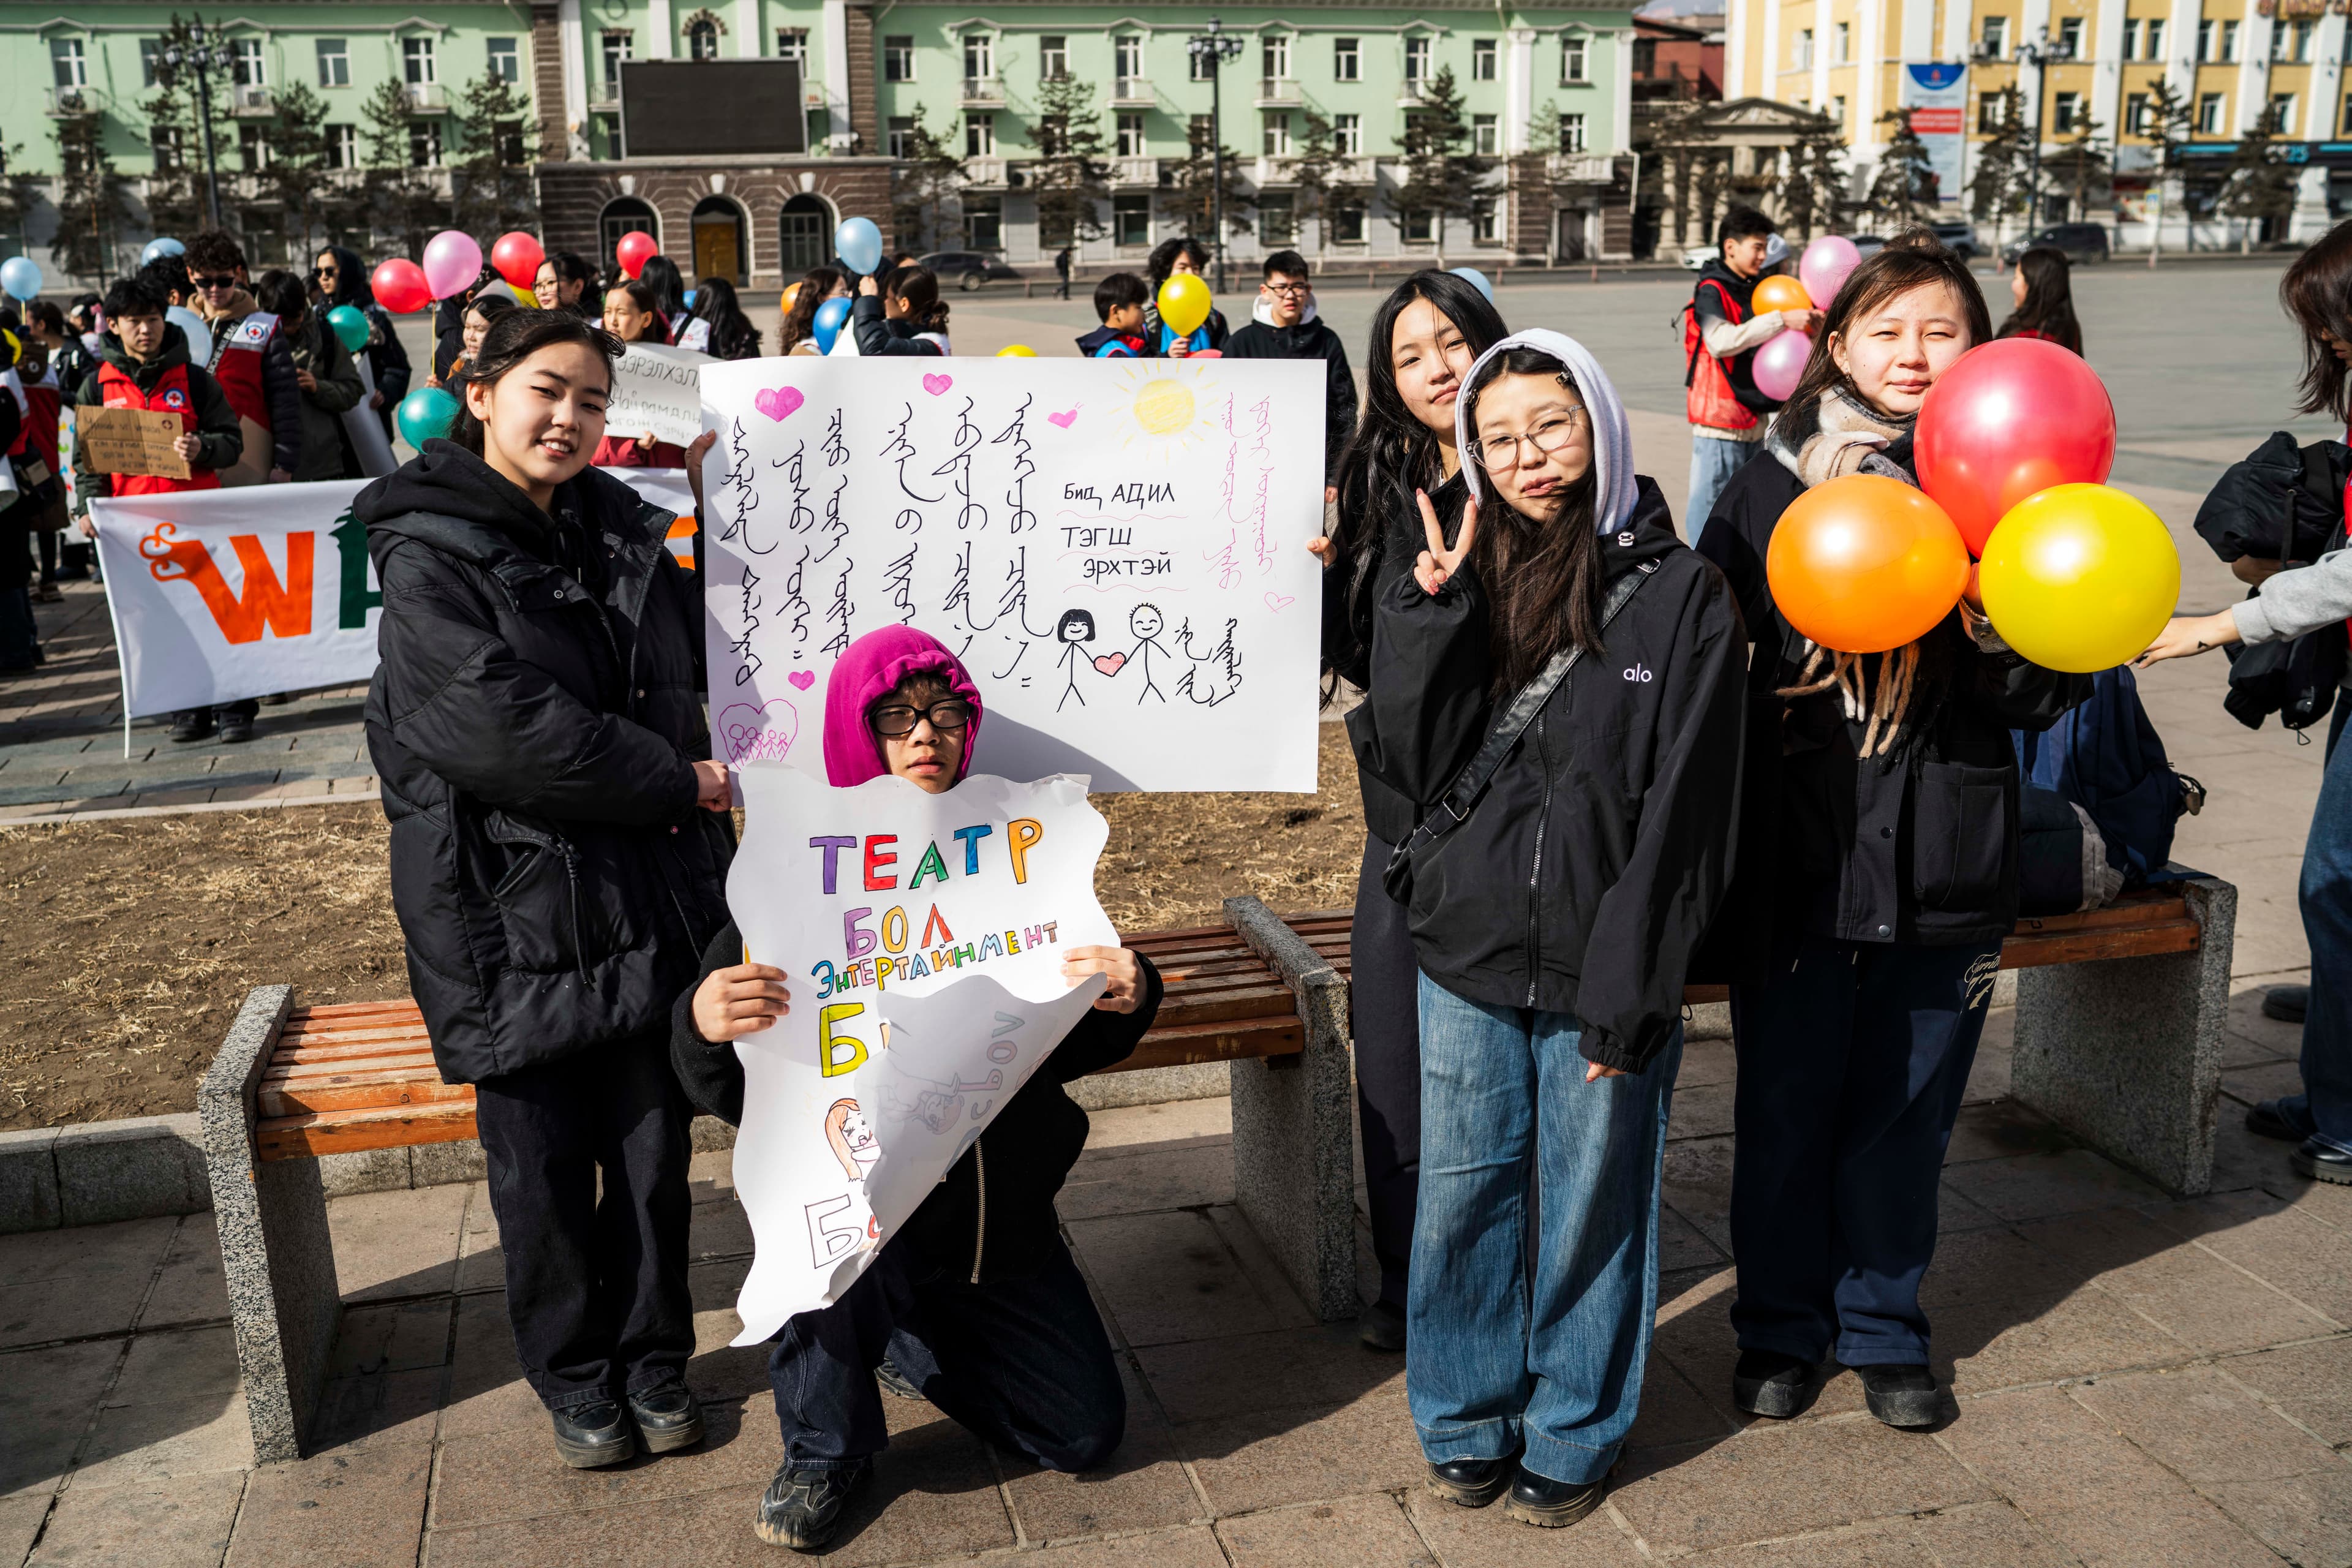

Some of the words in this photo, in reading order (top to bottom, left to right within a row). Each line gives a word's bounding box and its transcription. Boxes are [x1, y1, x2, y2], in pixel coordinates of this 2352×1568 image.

[617, 355, 700, 393] ЭЭРЭЛХЭЛ
[1065, 483, 1102, 510] Бид
[1111, 483, 1175, 510] АДИЛ
[1060, 527, 1131, 548] ТЭГШ
[1084, 552, 1170, 585] ЭРХТЭЙ
[1623, 663, 1653, 682] alo
[809, 817, 1044, 894] ТЕАТР
[844, 903, 955, 960] БОЛ
[820, 1002, 891, 1078] Б
